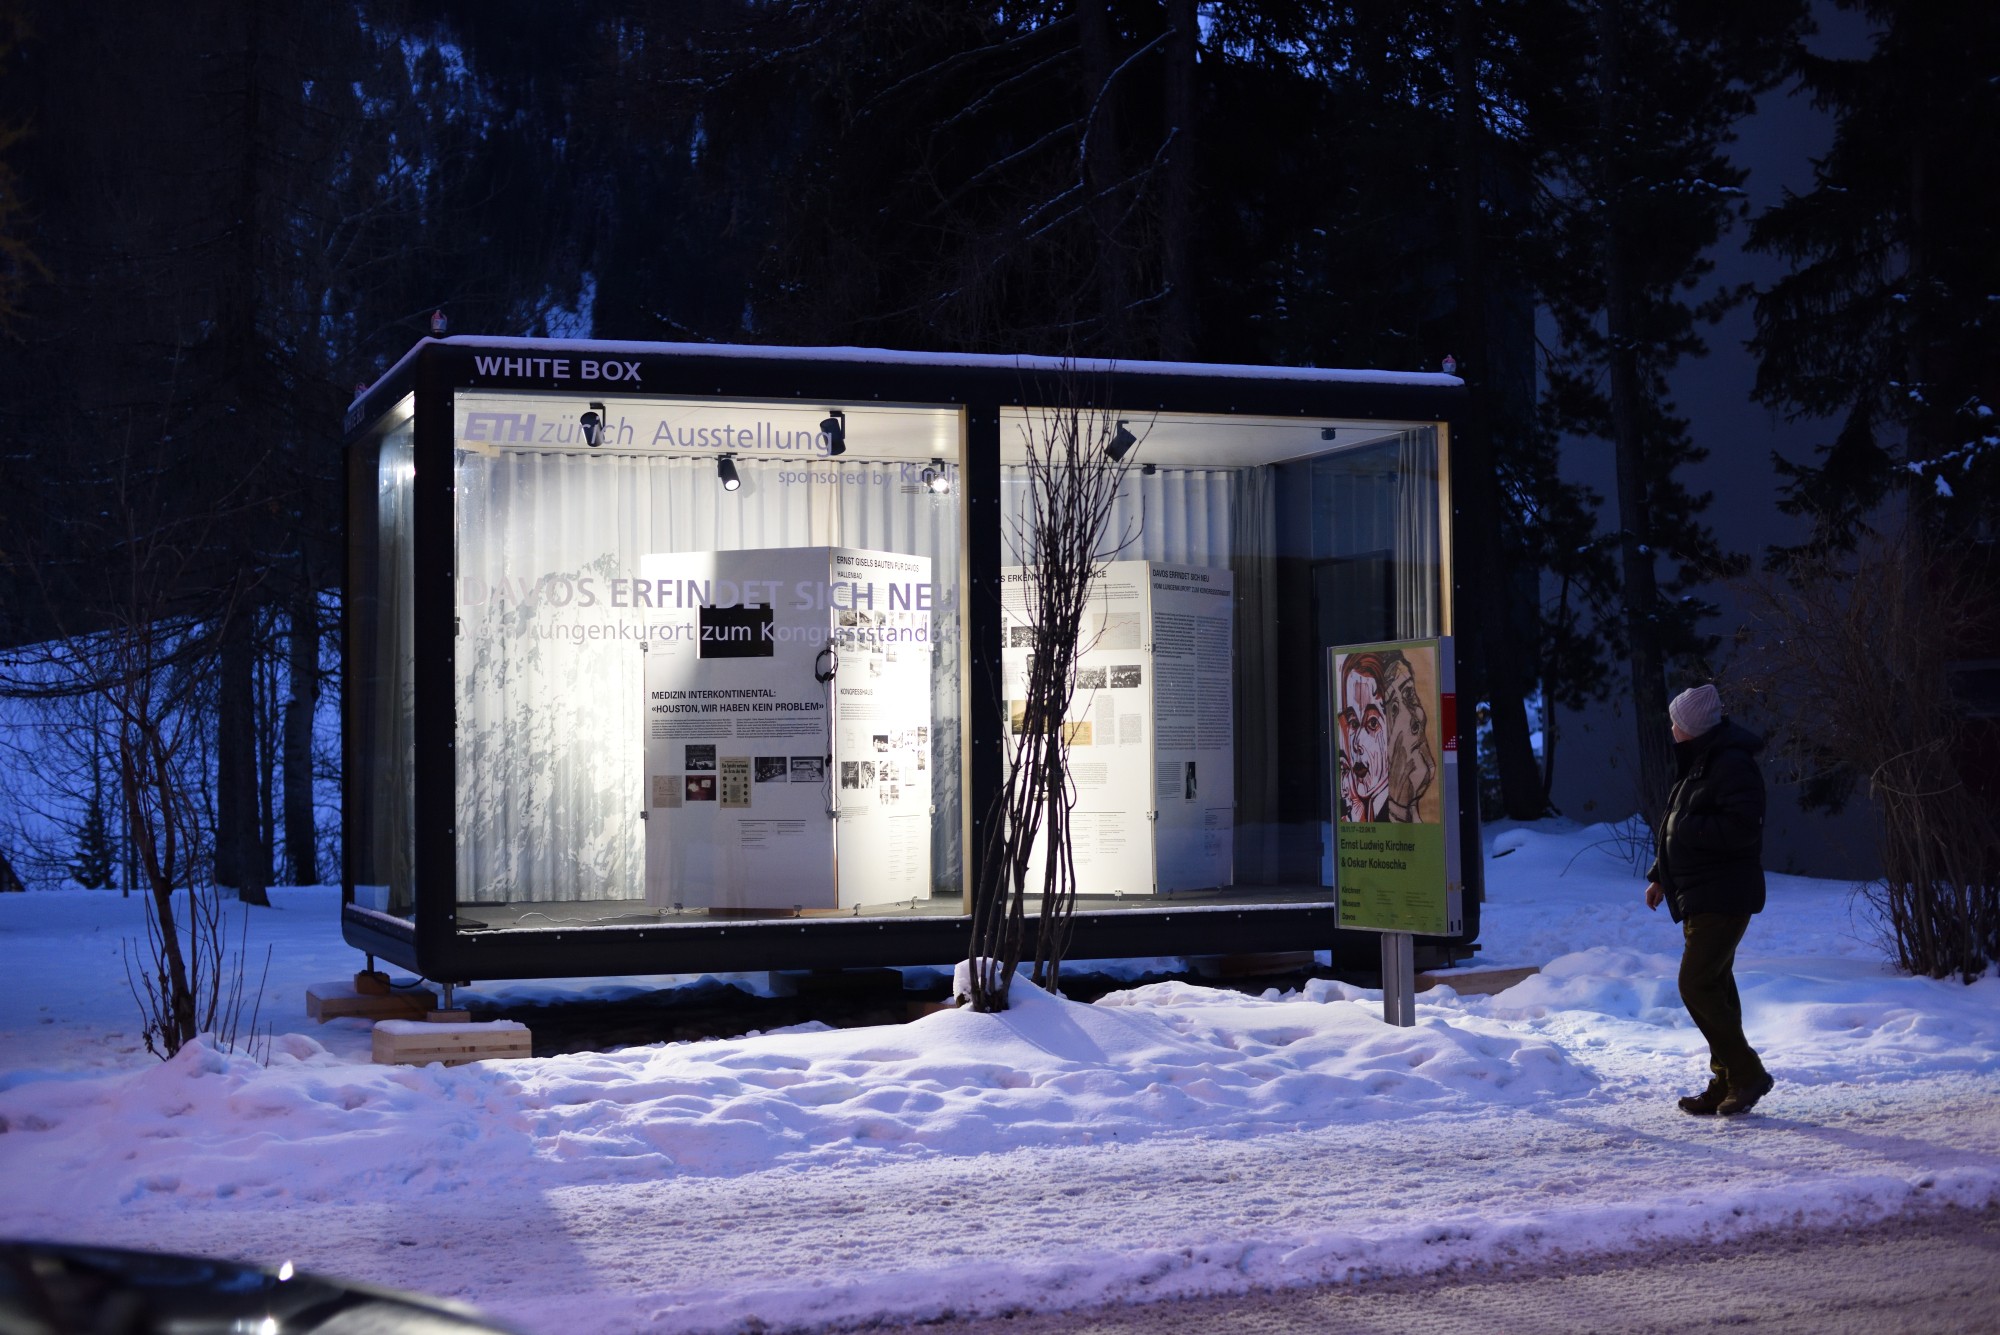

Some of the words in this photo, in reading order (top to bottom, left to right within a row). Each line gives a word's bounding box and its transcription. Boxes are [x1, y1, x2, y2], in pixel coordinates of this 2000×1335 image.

[474, 355, 571, 379] WHITE
[581, 360, 642, 382] BOX
[463, 412, 537, 442] ETH
[652, 420, 833, 458] Ausstellung
[778, 470, 866, 487] sponsored
[873, 473, 893, 489] by
[836, 556, 855, 566] ERNST
[855, 558, 874, 568] GISELS
[874, 560, 894, 570] BAUTEN
[1152, 569, 1169, 579] DAVOS
[1169, 571, 1190, 581] ERFINDET
[1190, 573, 1201, 583] SICH
[463, 576, 596, 608] DAVOS
[611, 578, 784, 609] ERFINDET
[794, 580, 874, 612] SICH
[888, 582, 960, 612] NEU
[526, 618, 695, 645] Lungenkurort
[701, 624, 752, 641] zum
[651, 691, 687, 700] MEDIZIN
[688, 689, 777, 699] INTERKONTINENTAL:
[651, 704, 700, 714] «HOUSTON,
[701, 704, 718, 713] WIR
[719, 703, 750, 712] HABEN
[752, 703, 773, 712] KEIN
[774, 702, 824, 711] PROBLEM»
[1340, 839, 1358, 850] Ernst
[1360, 840, 1385, 853] Ludwig
[1385, 841, 1415, 851] Kirchner
[1347, 857, 1367, 868] Oskar
[1368, 858, 1407, 870] Kokoschka
